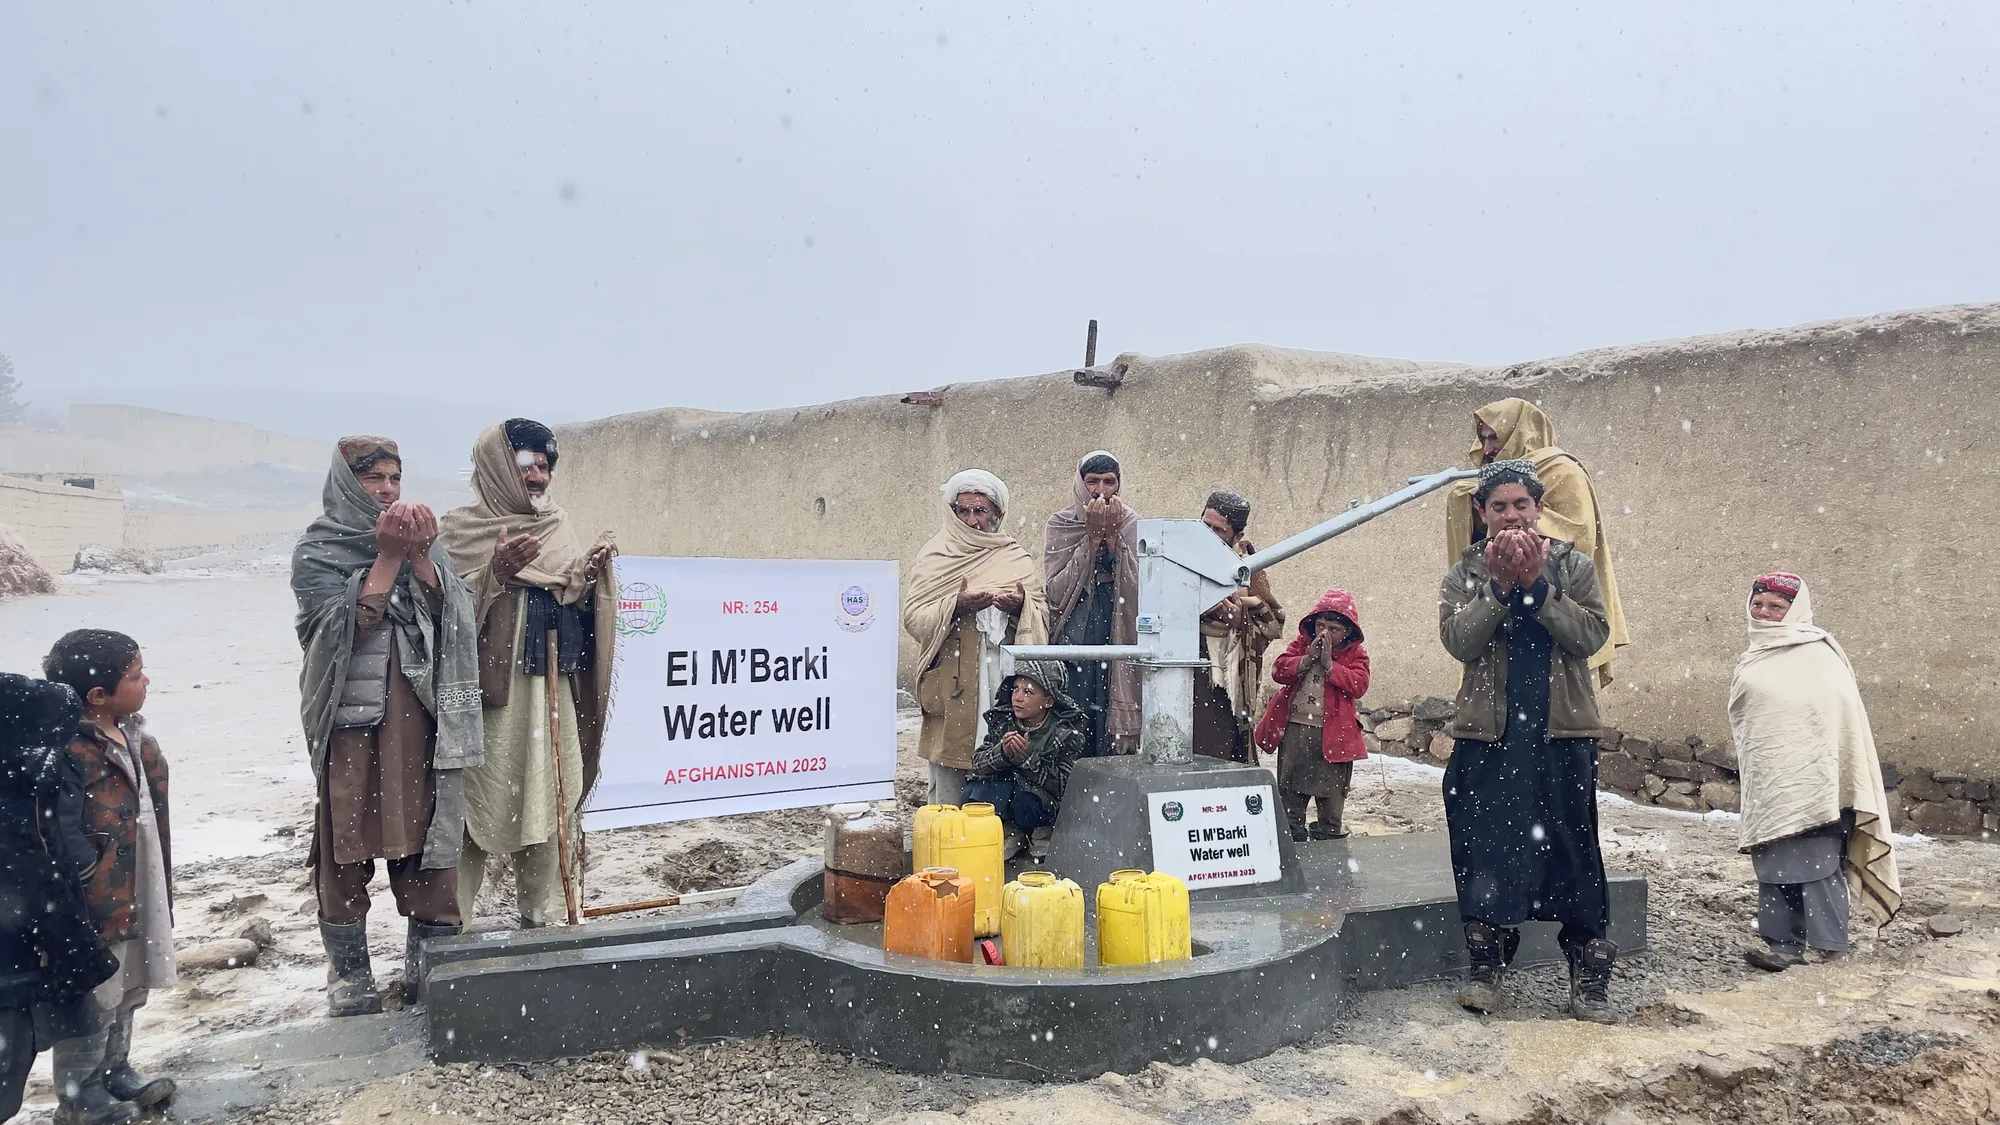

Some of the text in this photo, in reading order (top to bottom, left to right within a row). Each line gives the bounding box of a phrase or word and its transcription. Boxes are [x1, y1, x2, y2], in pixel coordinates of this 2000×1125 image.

[722, 601, 779, 614] NR: 254
[847, 596, 864, 604] HAS
[667, 651, 698, 687] El
[663, 697, 830, 741] Water well
[664, 757, 827, 785] AFGHANISTAN 2023
[1188, 829, 1200, 843] El
[1190, 844, 1250, 861] Water well
[1240, 868, 1256, 877] 2023
